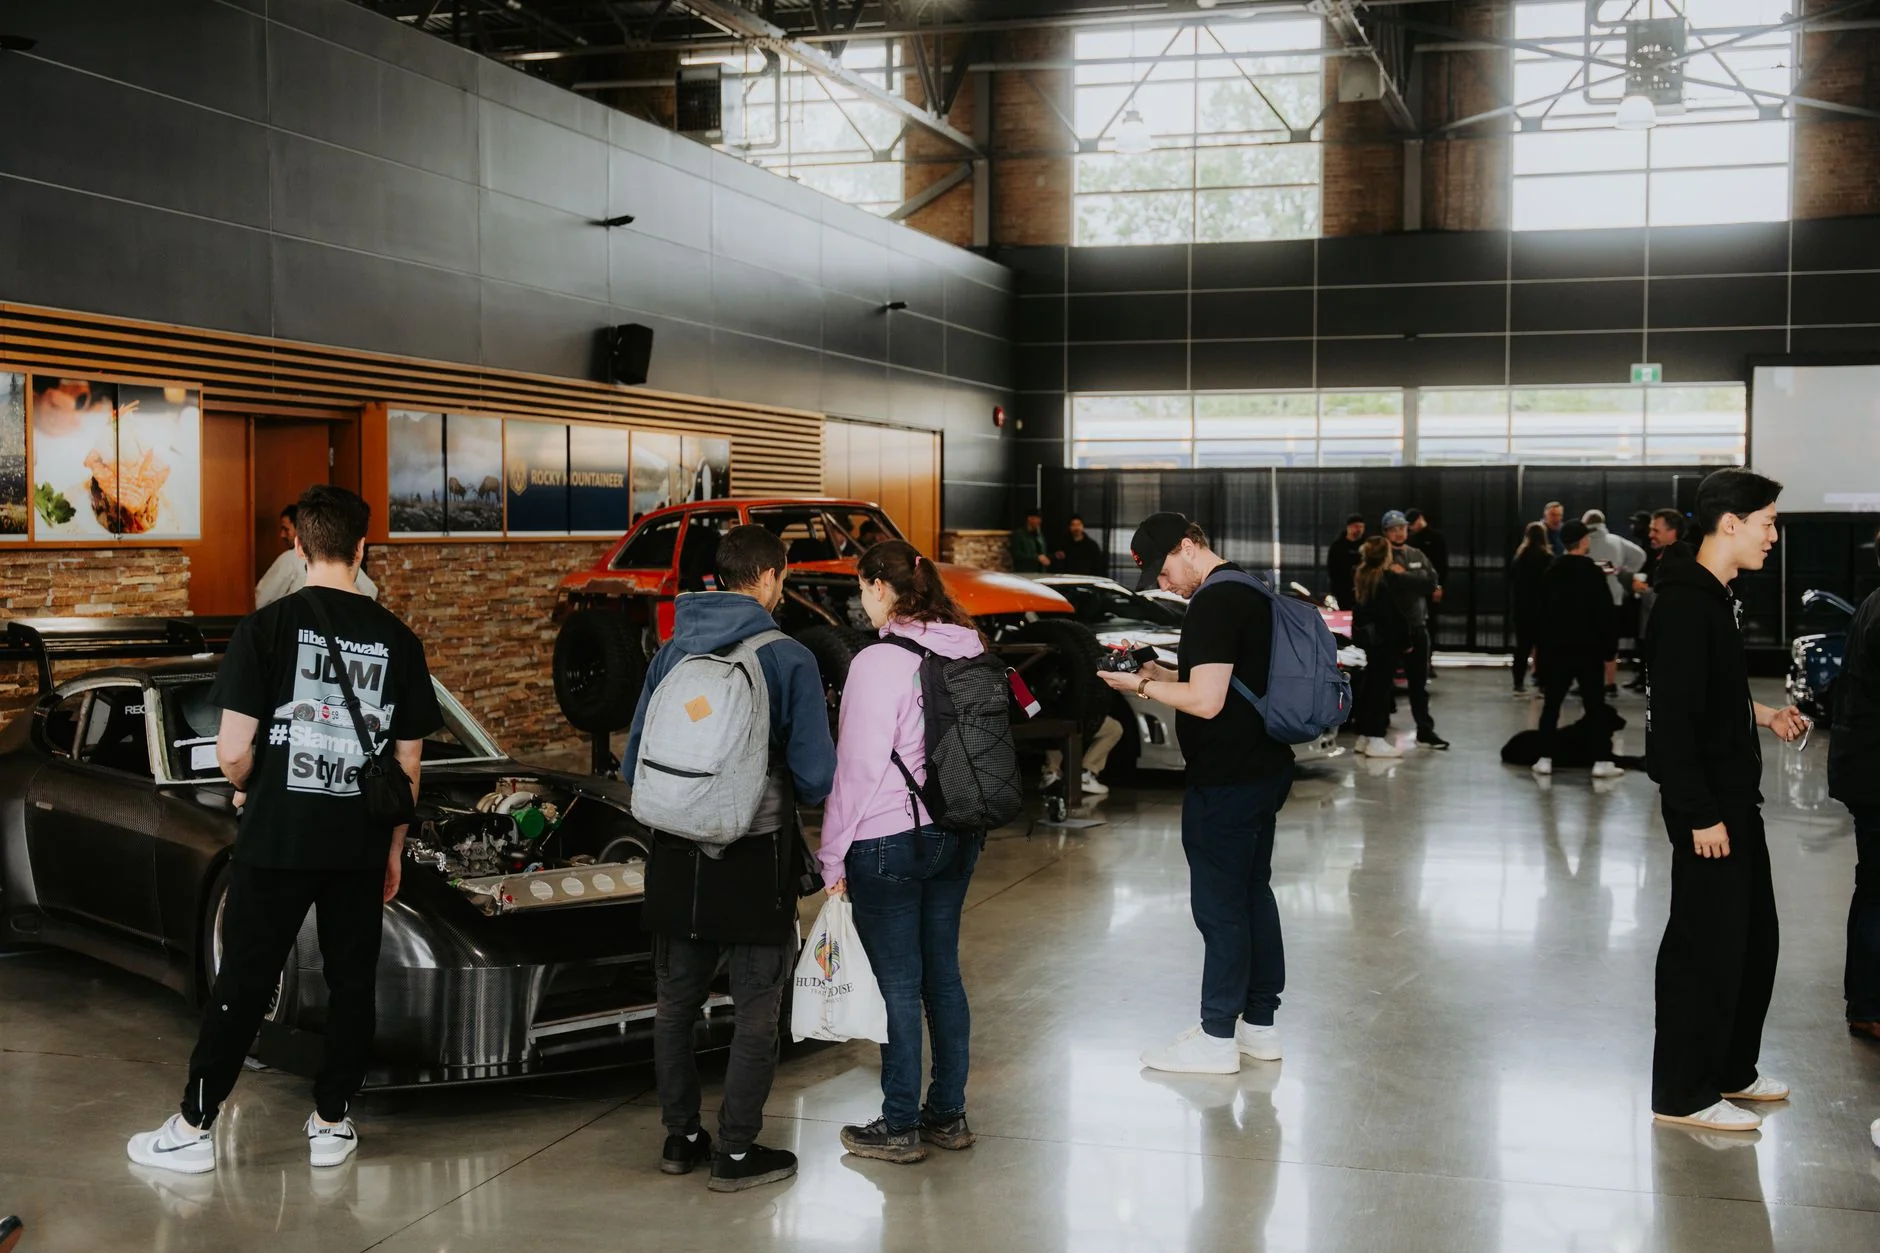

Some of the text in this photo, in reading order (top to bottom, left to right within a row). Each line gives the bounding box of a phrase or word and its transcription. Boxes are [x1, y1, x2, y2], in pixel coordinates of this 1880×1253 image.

[531, 469, 561, 486] ROCKY
[298, 628, 389, 658] libeywalk
[269, 724, 388, 757] #Slammd
[292, 752, 362, 788] Style
[887, 1136, 909, 1145] HOKA
